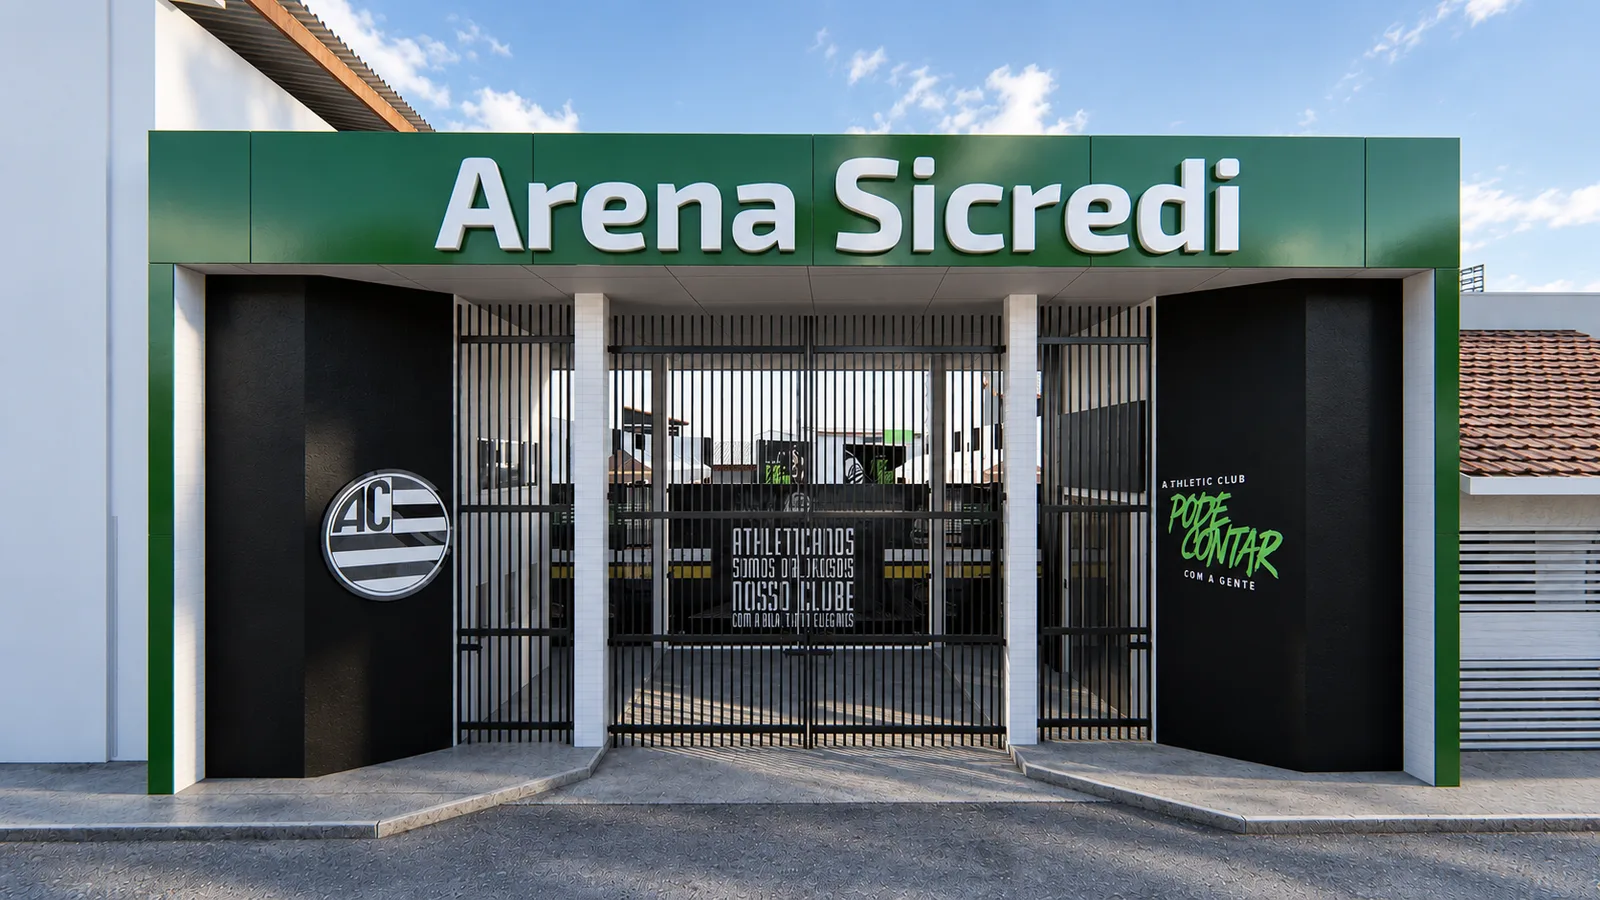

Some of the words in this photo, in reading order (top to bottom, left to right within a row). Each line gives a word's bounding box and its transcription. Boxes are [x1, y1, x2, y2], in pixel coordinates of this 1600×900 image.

[435, 157, 796, 252] Arena
[835, 156, 1242, 254] Sicredi
[1161, 477, 1213, 489] ATHLETIC
[1217, 474, 1246, 485] CLUB
[332, 479, 391, 533] AC
[1168, 491, 1232, 541] PODE
[1181, 524, 1283, 579] CONTAR
[732, 581, 790, 611] NOSSO
[800, 581, 855, 611] CLUBE
[1184, 569, 1203, 581] COM
[1208, 574, 1215, 584] A
[1219, 577, 1256, 591] GENTE
[732, 613, 752, 627] COM
